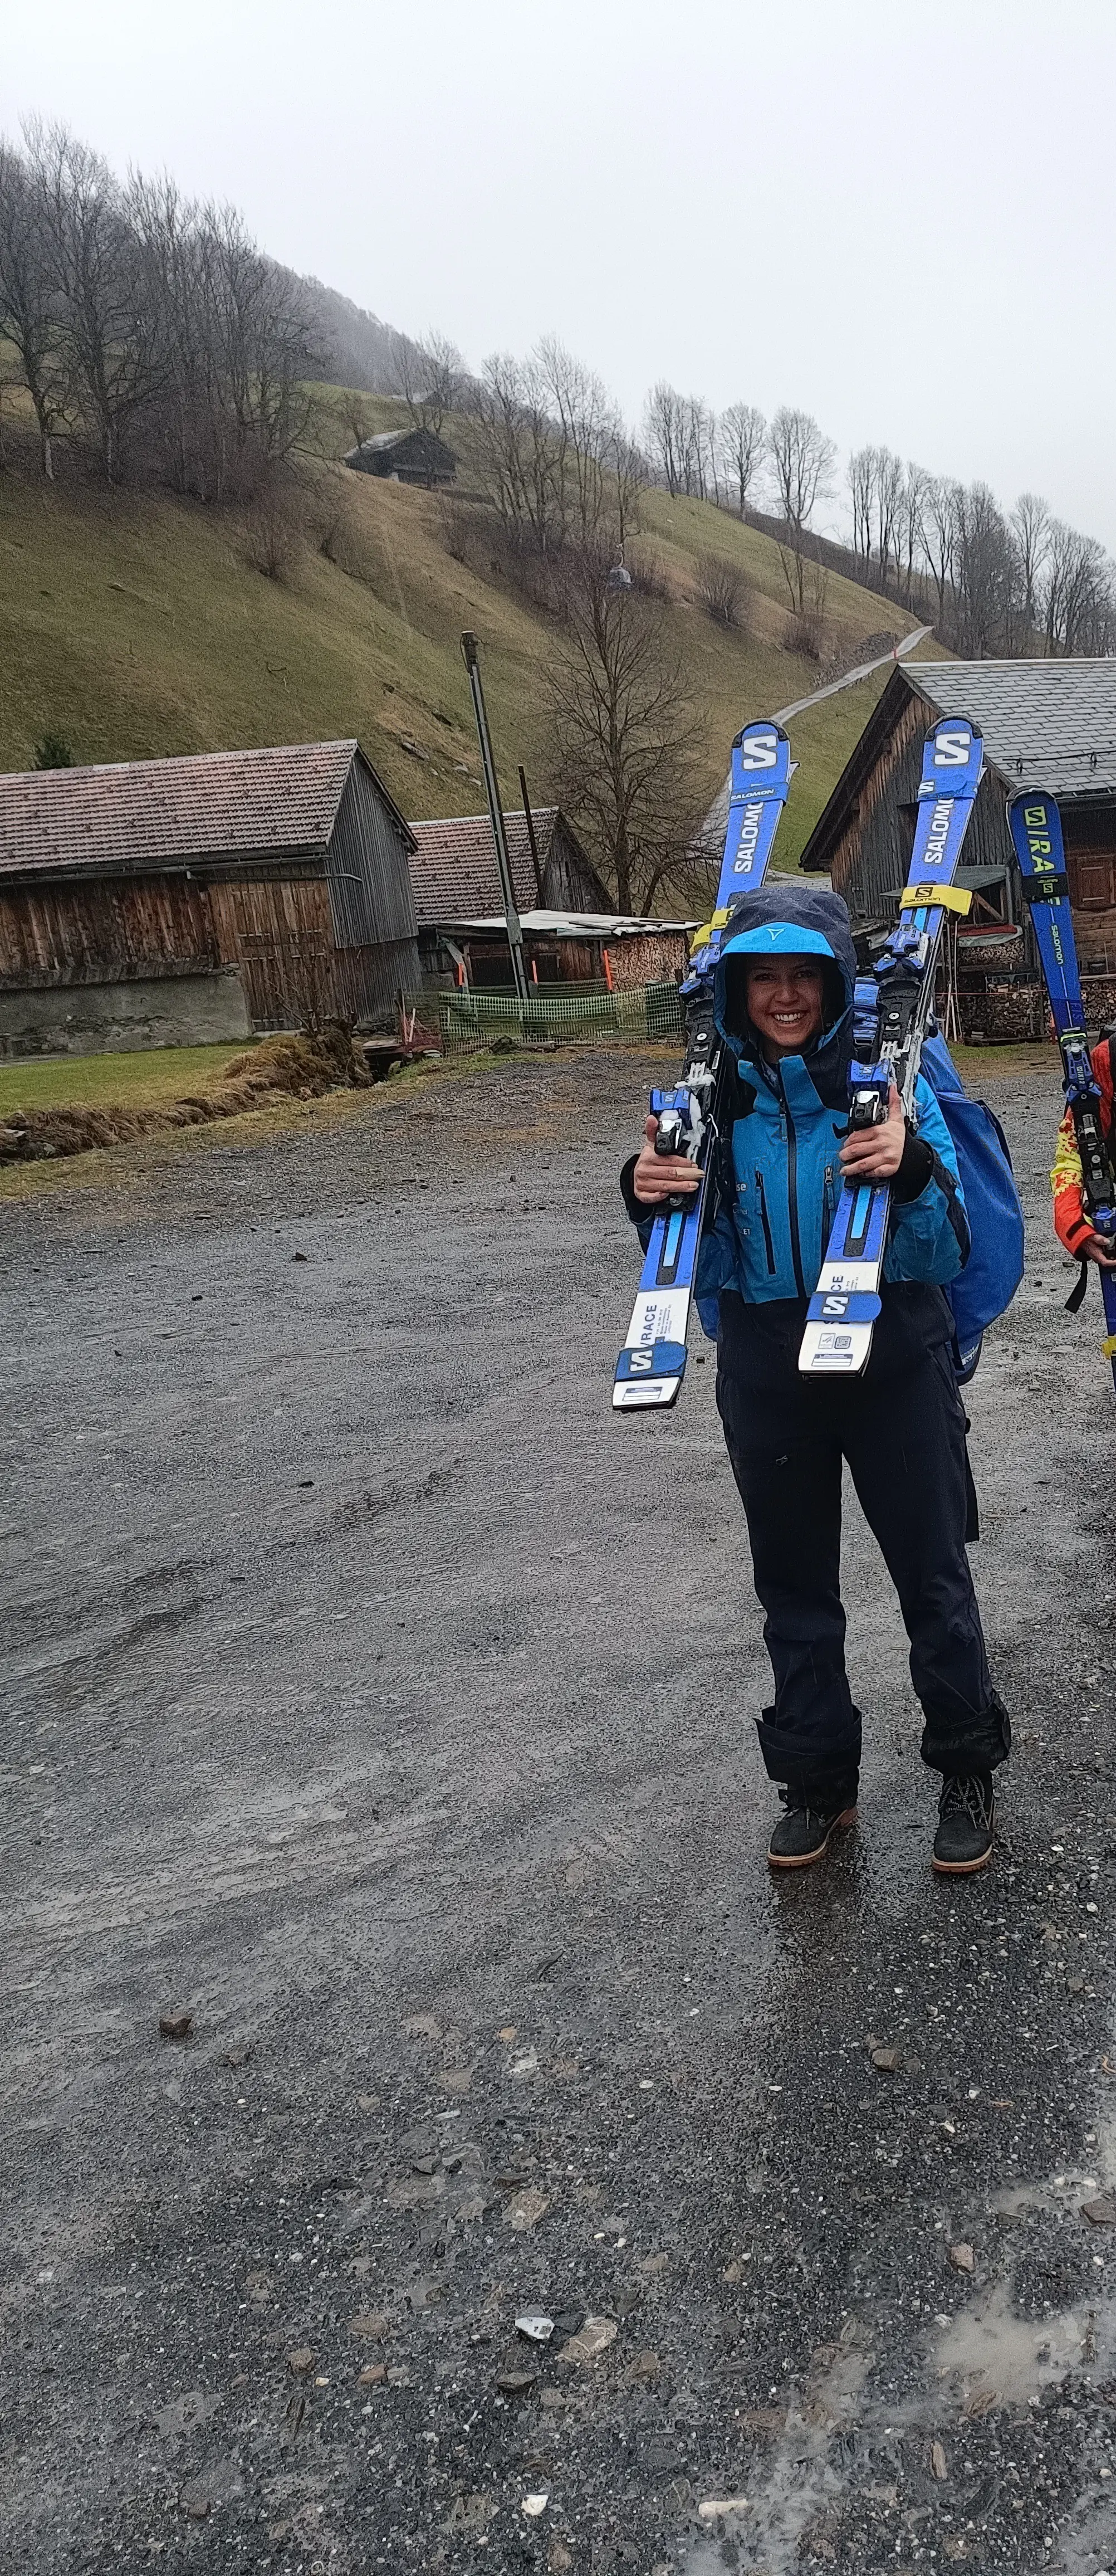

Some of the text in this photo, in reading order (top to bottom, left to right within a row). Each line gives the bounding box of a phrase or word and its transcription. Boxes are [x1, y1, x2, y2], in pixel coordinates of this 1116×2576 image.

[743, 735, 777, 769] S
[935, 733, 970, 765] S
[731, 789, 775, 801] SALOMON
[916, 887, 933, 897] S
[1051, 925, 1063, 964] salomon
[823, 1296, 849, 1315] S
[630, 1350, 653, 1372] S
